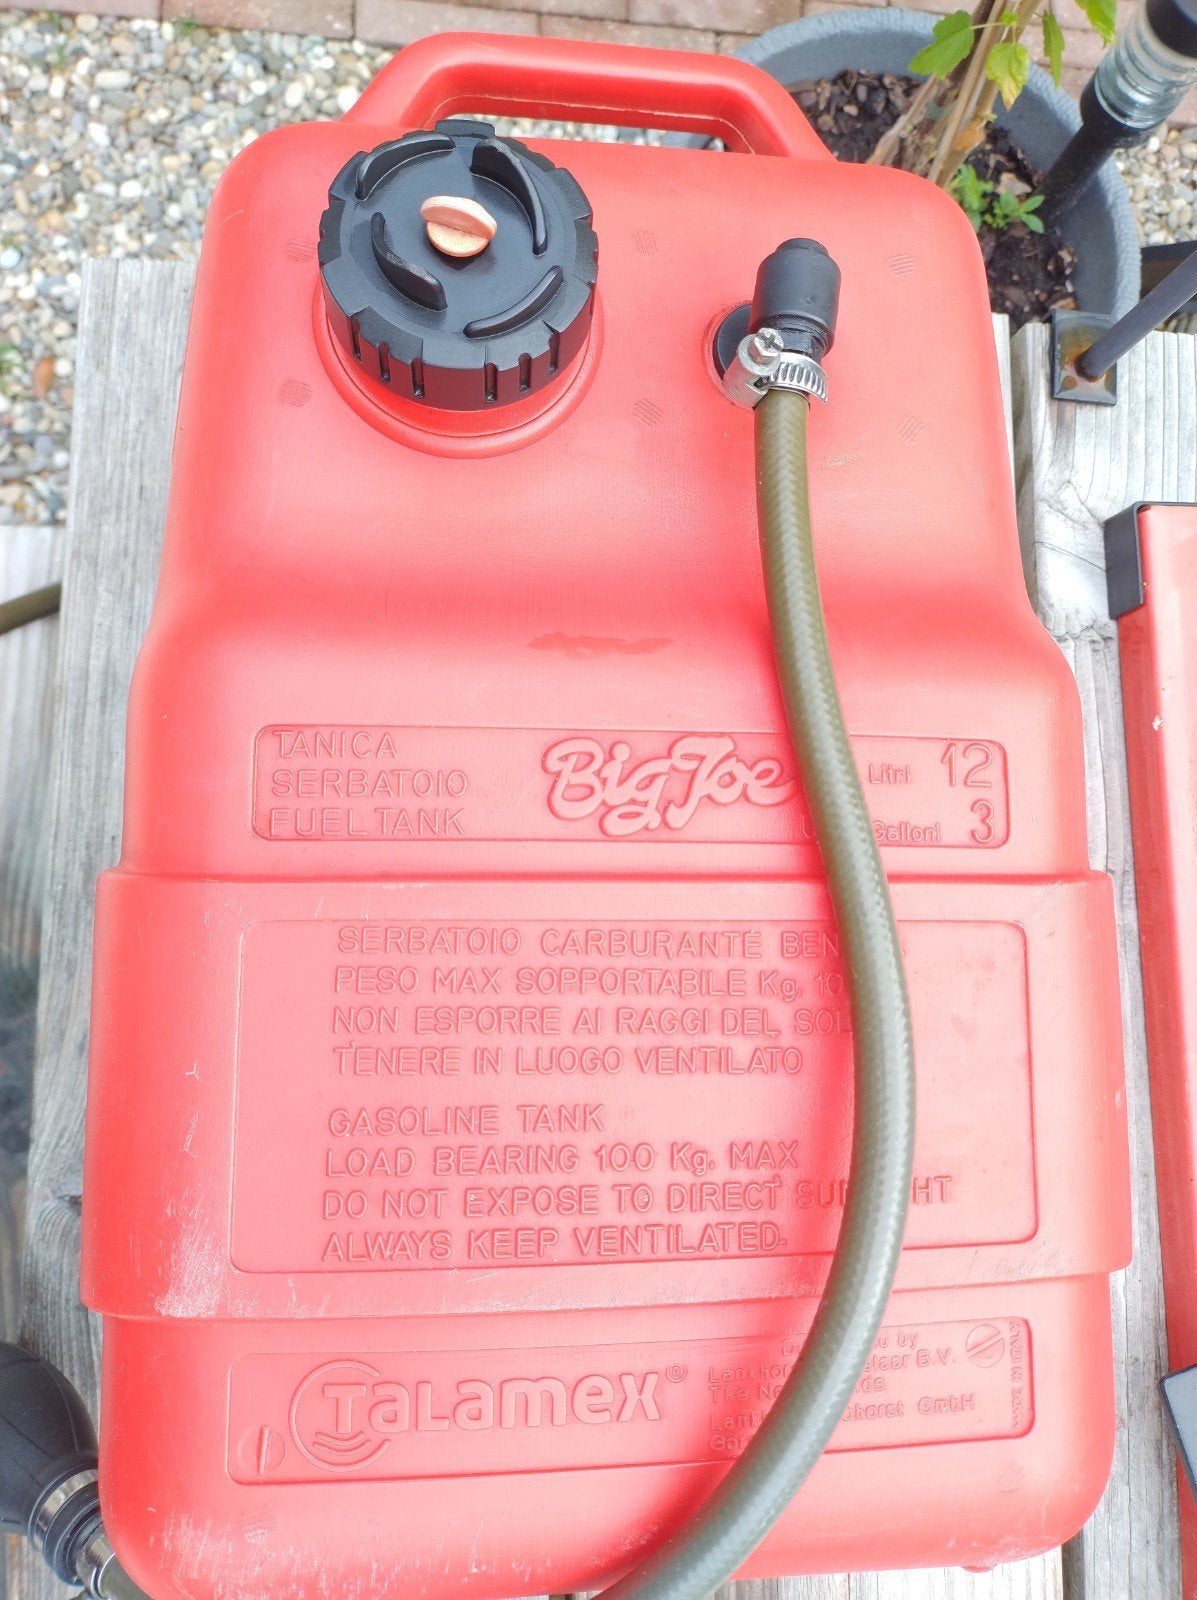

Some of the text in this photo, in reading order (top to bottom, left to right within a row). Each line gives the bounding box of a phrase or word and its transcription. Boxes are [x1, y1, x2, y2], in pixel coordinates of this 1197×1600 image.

[272, 731, 397, 759] TANICA
[868, 742, 993, 788] Litri 12
[271, 769, 469, 798] SERBATOIO
[268, 806, 465, 837] FUEL TANK
[969, 798, 996, 845] 3
[337, 925, 840, 959] SERBATOIO CARBURANTE BEN
[334, 966, 421, 995] PESO
[433, 966, 502, 995] MAX
[515, 966, 747, 997] SOPPORTABILE
[814, 972, 844, 997] 10
[333, 1005, 854, 1037] NON ESPORRE AI RAGGI DEL SOL
[332, 1046, 803, 1076] TENERE IN LUOGO VENTILATO
[328, 1103, 605, 1137] GASOLINE TANK
[325, 1147, 416, 1178] LOAD
[433, 1144, 579, 1177] BEARING
[594, 1141, 656, 1173] 100
[728, 1140, 799, 1171] MAX
[322, 1189, 369, 1221] DO
[381, 1187, 449, 1220] NOT
[463, 1184, 599, 1218] EXPOSE
[612, 1182, 654, 1214] TO
[666, 1179, 783, 1213] DIRECT
[322, 1230, 453, 1262] ALWAYS
[467, 1227, 559, 1260] KEEP
[917, 1392, 976, 1416] GmbH
